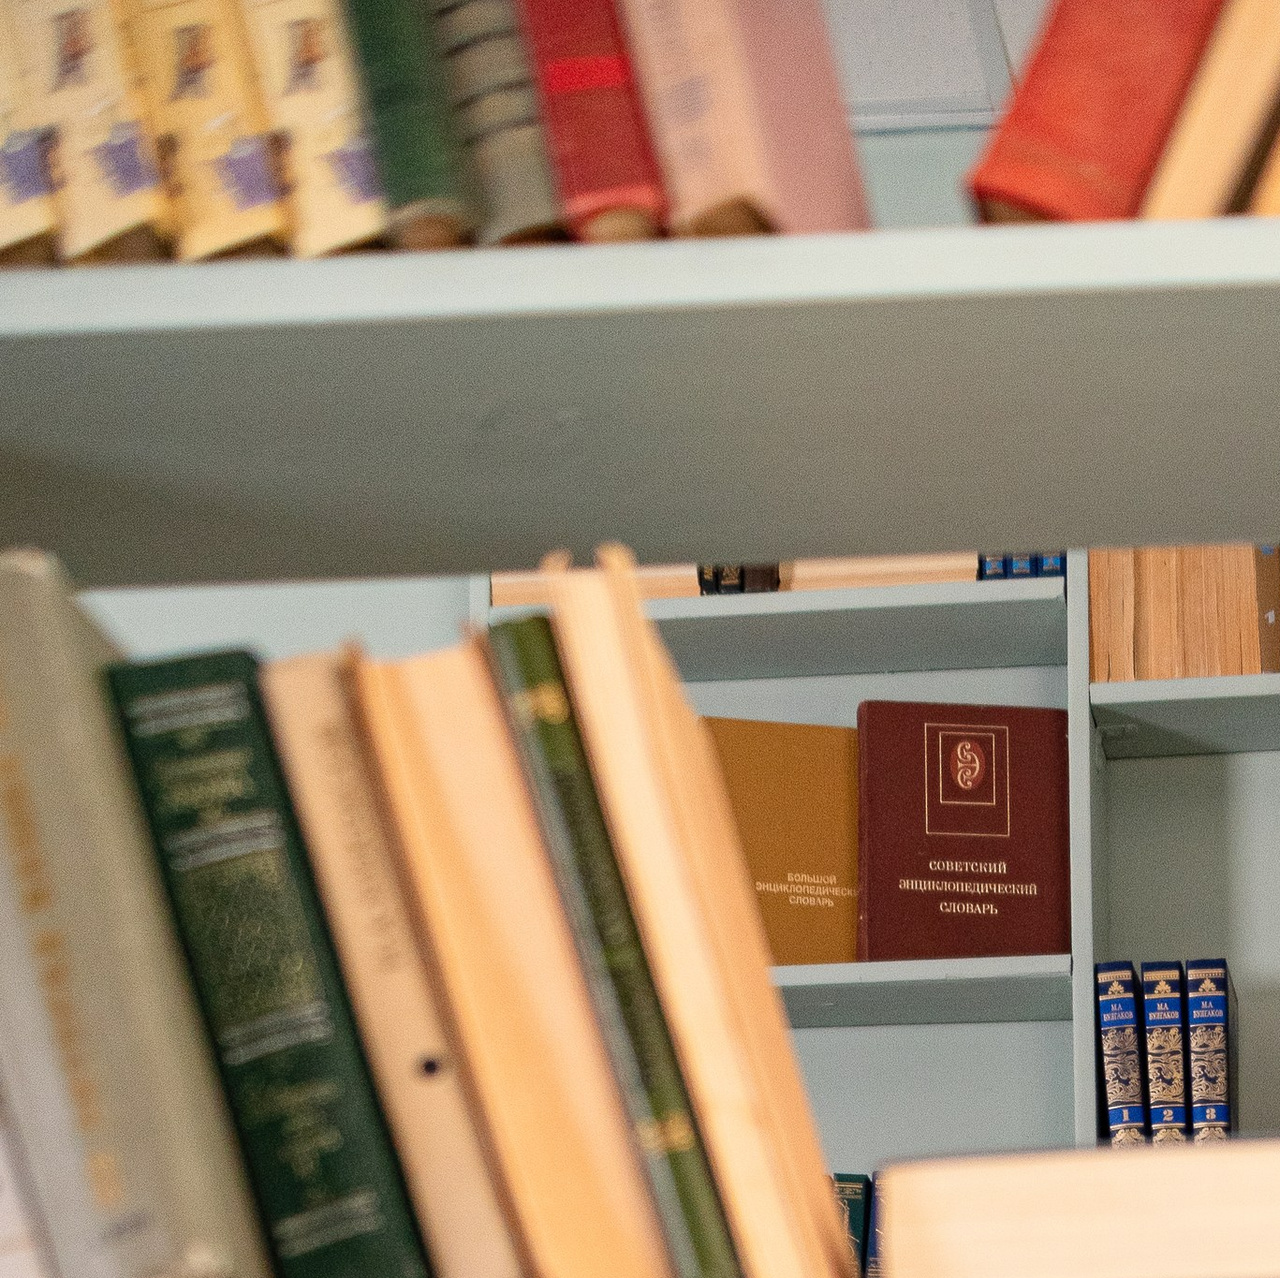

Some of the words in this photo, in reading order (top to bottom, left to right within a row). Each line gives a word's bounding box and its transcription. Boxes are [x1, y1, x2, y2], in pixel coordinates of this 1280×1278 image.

[929, 859, 1008, 875] СОВЕТСКИЙ
[787, 872, 837, 885] БОЛЬШОЙ
[755, 882, 859, 897] ЭНЦИКЛОПЕДИЧЕСК
[898, 878, 1038, 897] ЭНЦИКЛОПЕДИЧЕСКИЙ
[788, 896, 834, 908] СЛОВАРЬ
[939, 901, 999, 916] СЛОВАРЬ
[1122, 1110, 1130, 1121] 1
[1163, 1109, 1174, 1121] 2
[1205, 1108, 1216, 1120] 3
